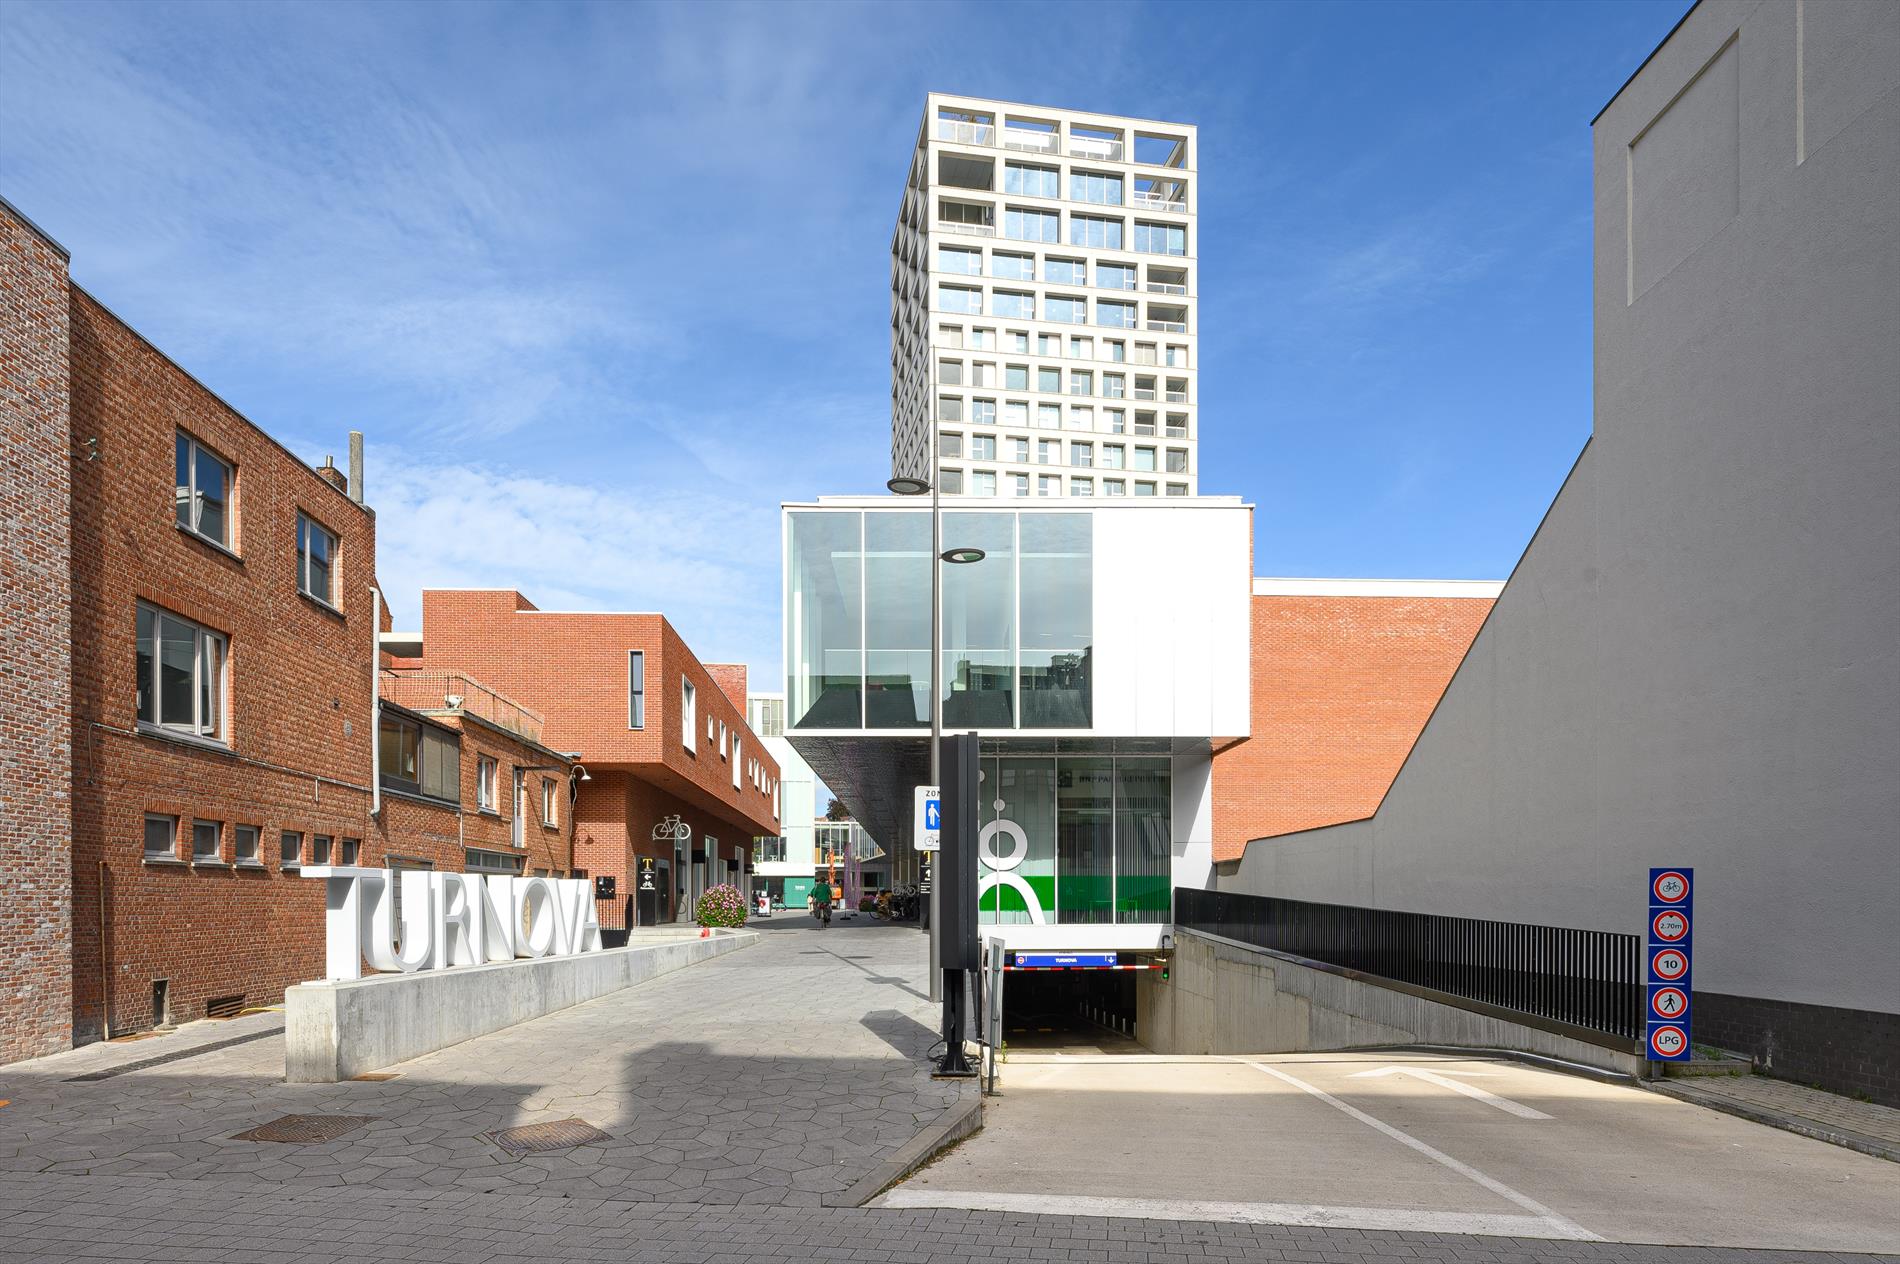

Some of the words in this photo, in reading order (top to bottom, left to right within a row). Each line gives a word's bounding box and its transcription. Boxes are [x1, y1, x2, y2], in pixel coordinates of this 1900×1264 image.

[642, 858, 653, 868] T
[300, 866, 603, 980] TURNOVA
[1663, 960, 1678, 969] 10
[1658, 1036, 1679, 1045] LPG
